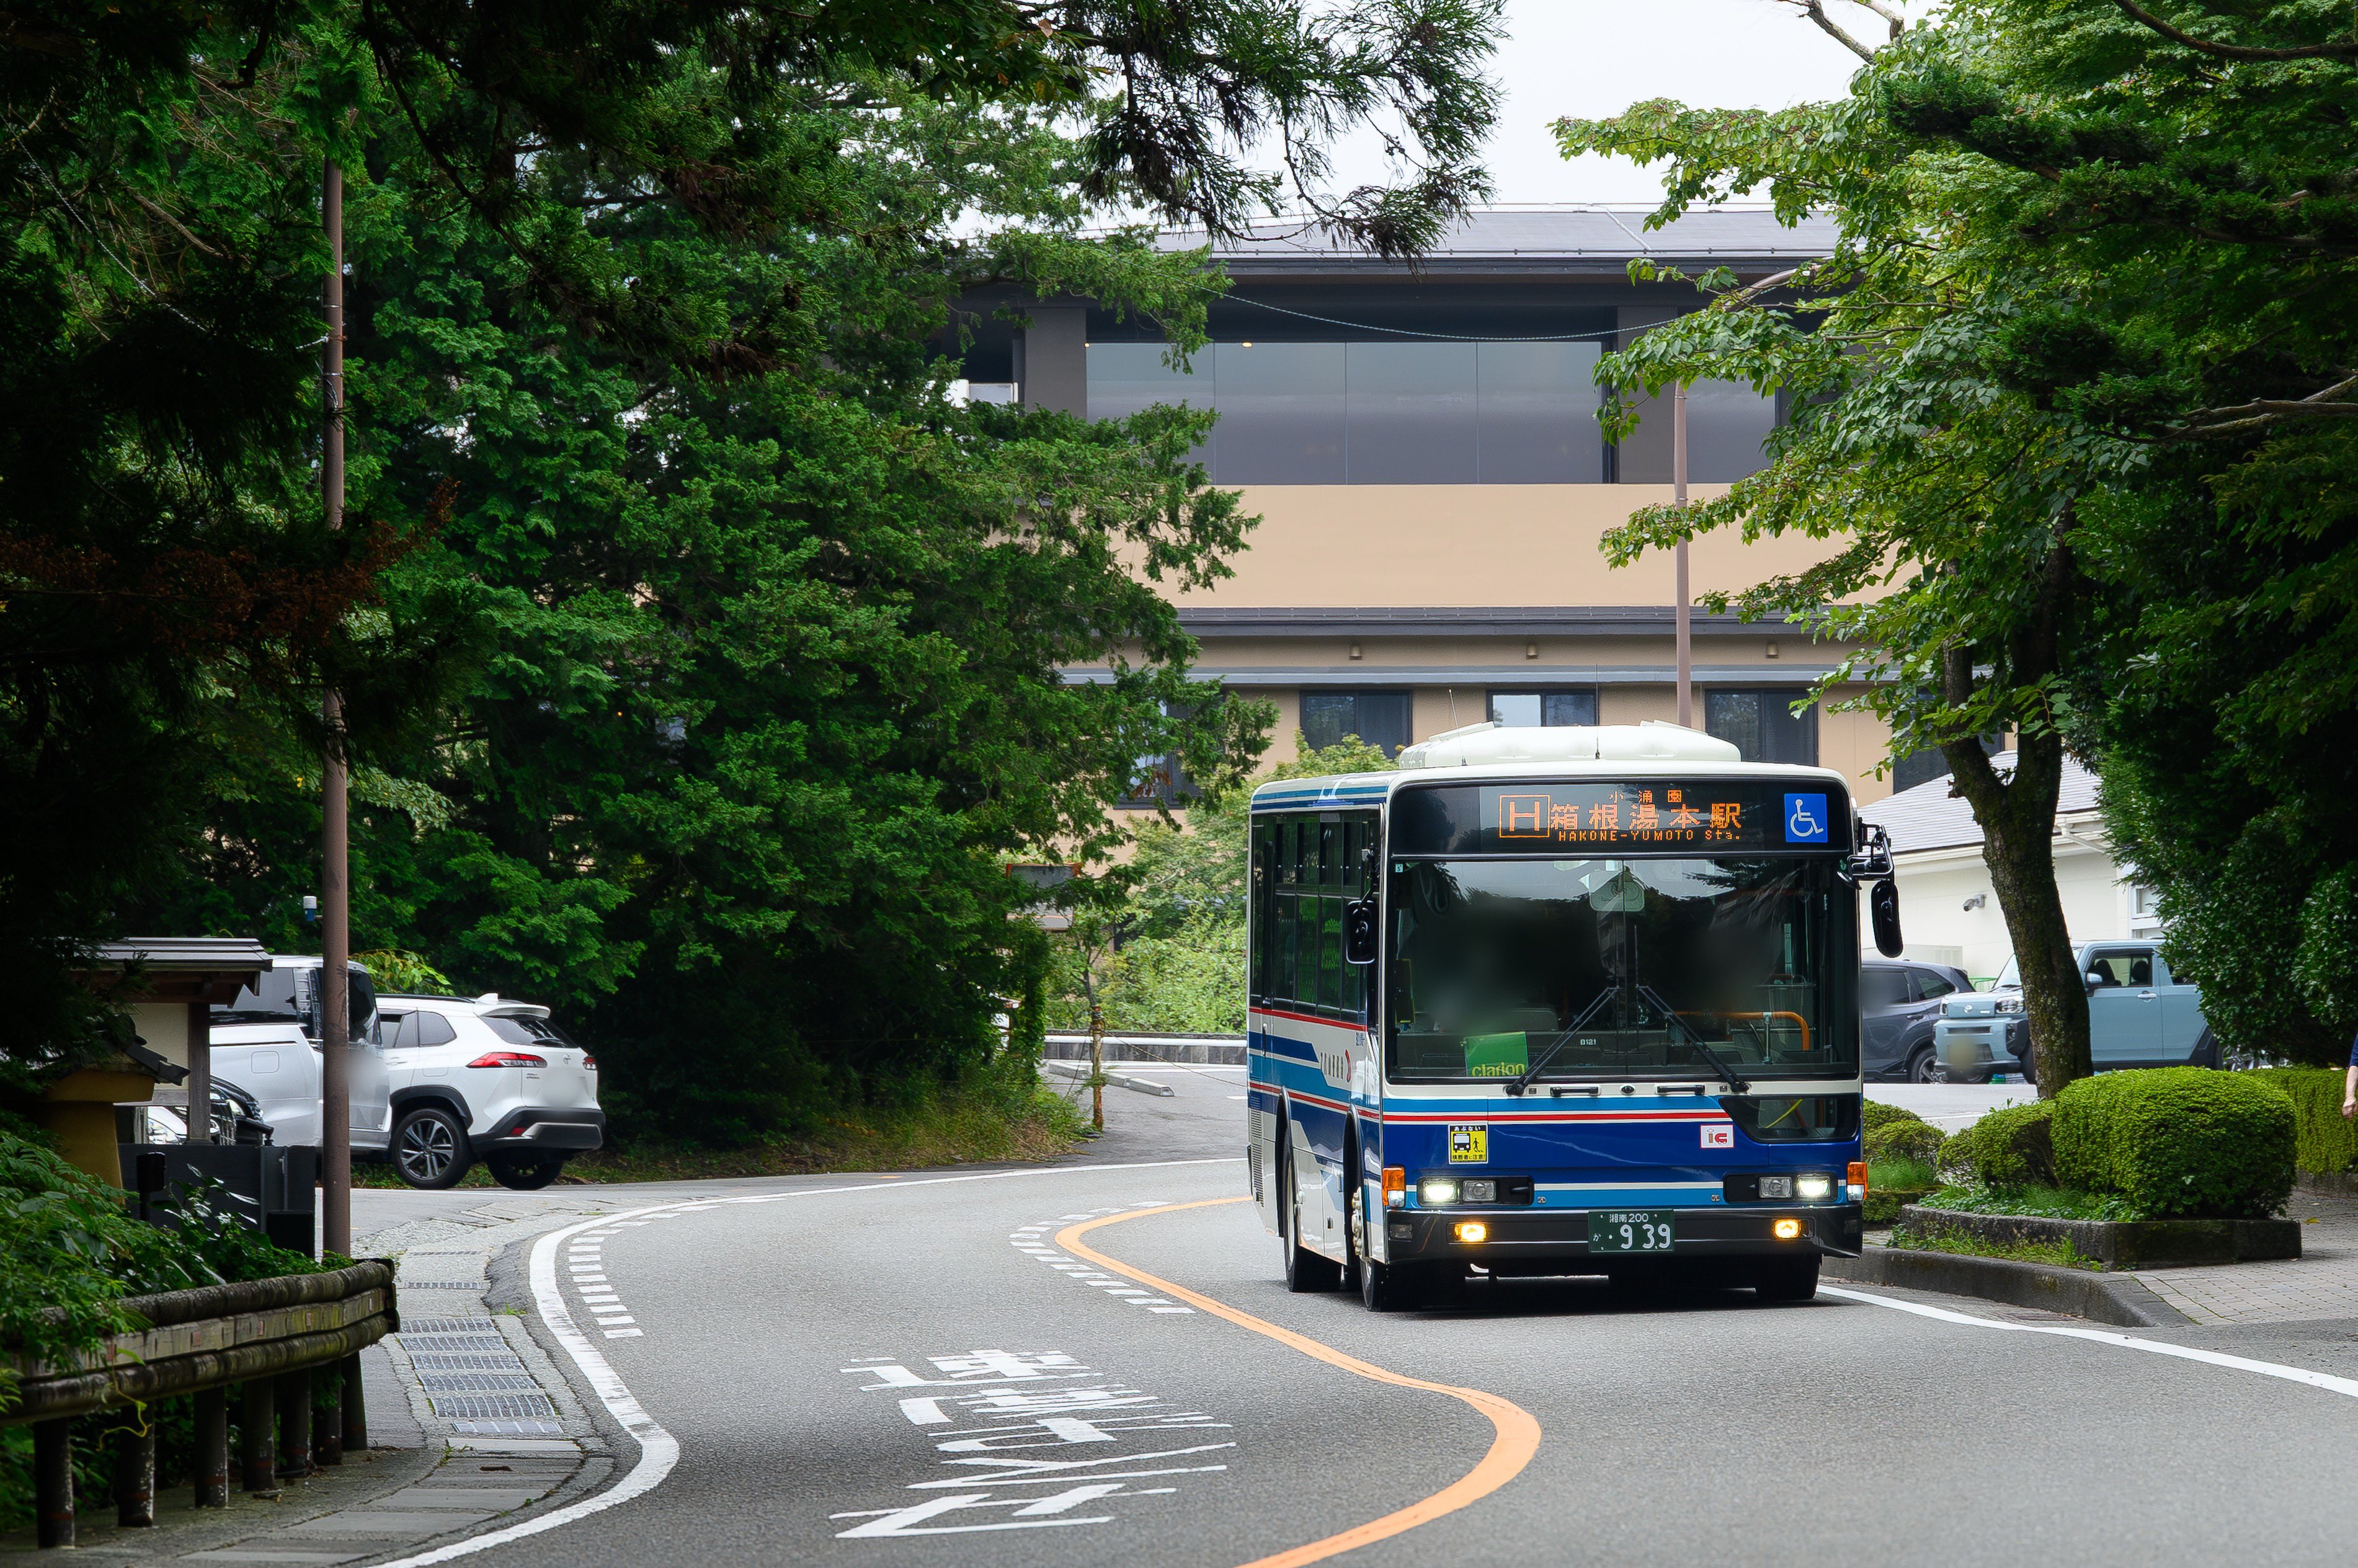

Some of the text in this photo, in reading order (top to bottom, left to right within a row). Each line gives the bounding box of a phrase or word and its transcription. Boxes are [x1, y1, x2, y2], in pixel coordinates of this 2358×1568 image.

[1509, 801, 1741, 831] H 箱根湯本駅
[1559, 830, 1740, 841] HAKONE-YUMOTO Sta.
[1472, 1061, 1525, 1076] clarion
[1593, 1233, 1601, 1241] か
[829, 1349, 1237, 1539] 速度おとせ
